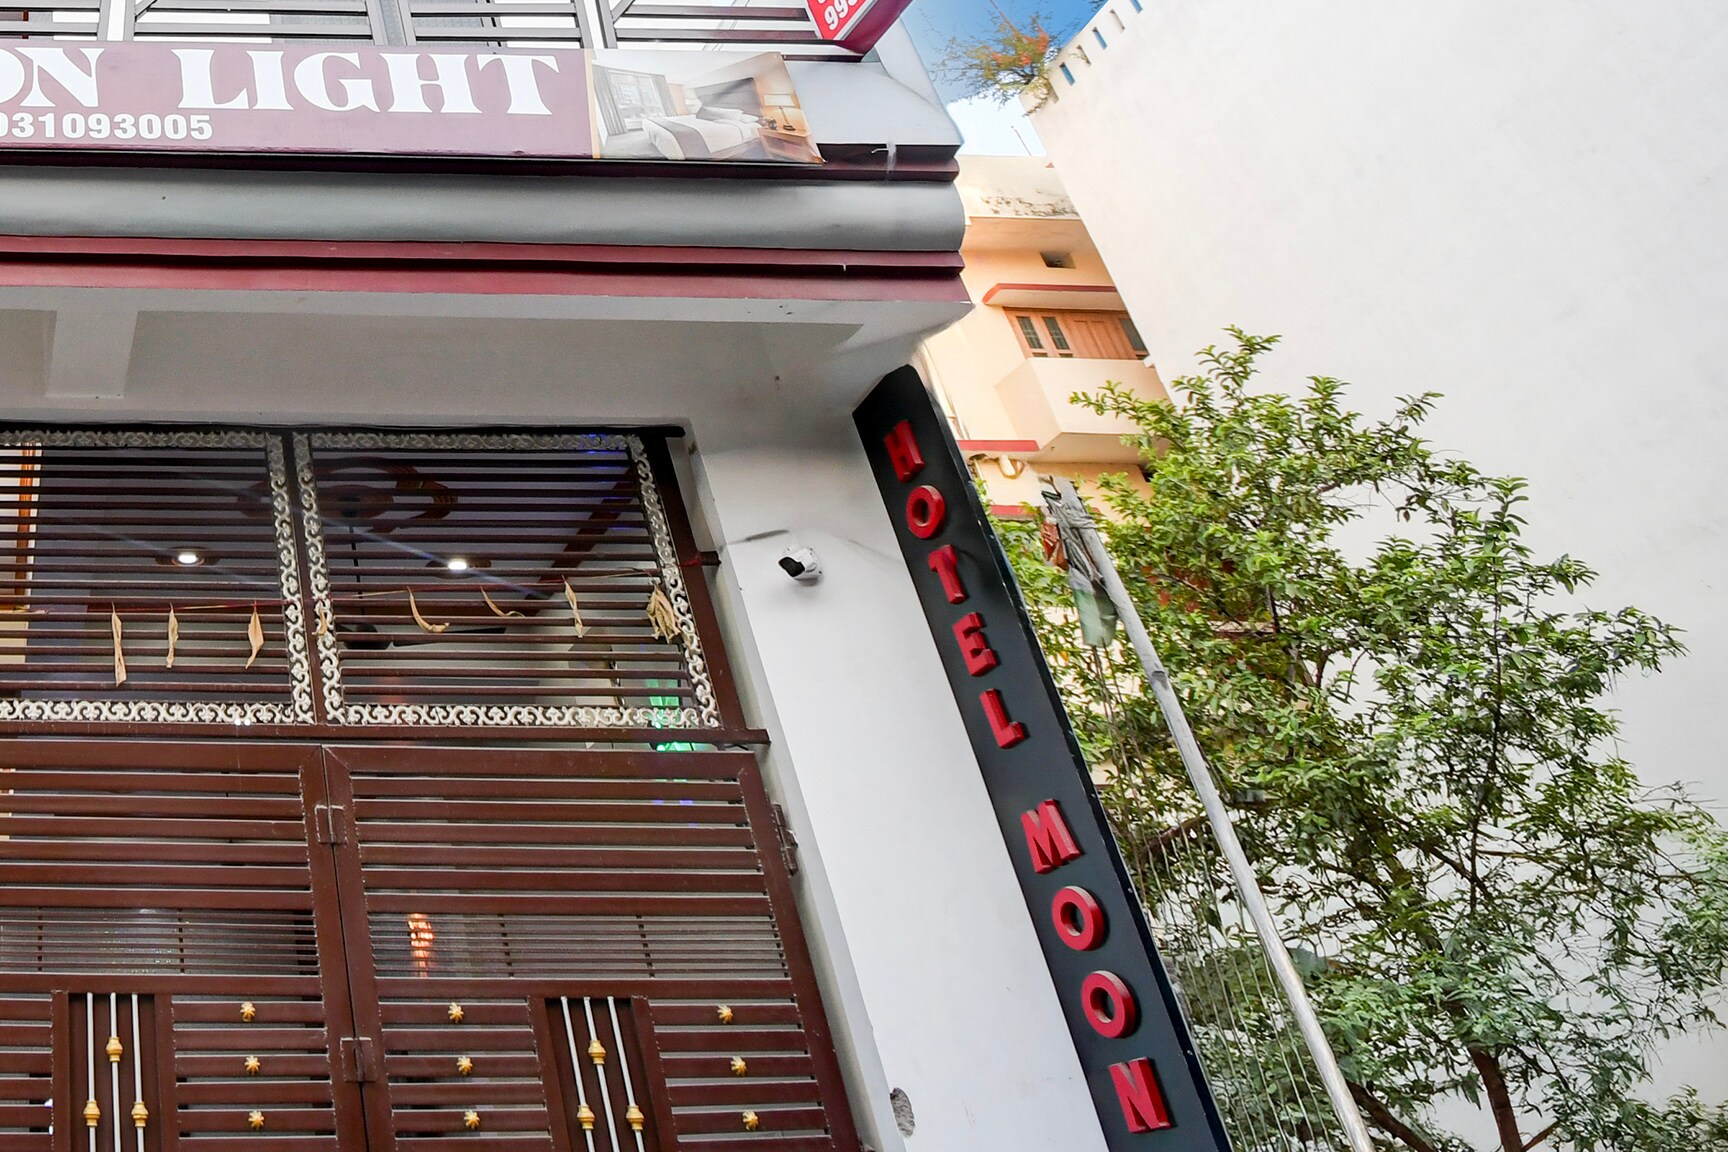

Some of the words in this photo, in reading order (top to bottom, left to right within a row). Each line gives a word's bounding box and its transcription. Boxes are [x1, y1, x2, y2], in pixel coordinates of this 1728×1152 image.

[171, 49, 560, 115] LIGHT
[883, 419, 1029, 749] HOTEL
[1022, 798, 1172, 1134] MOON
